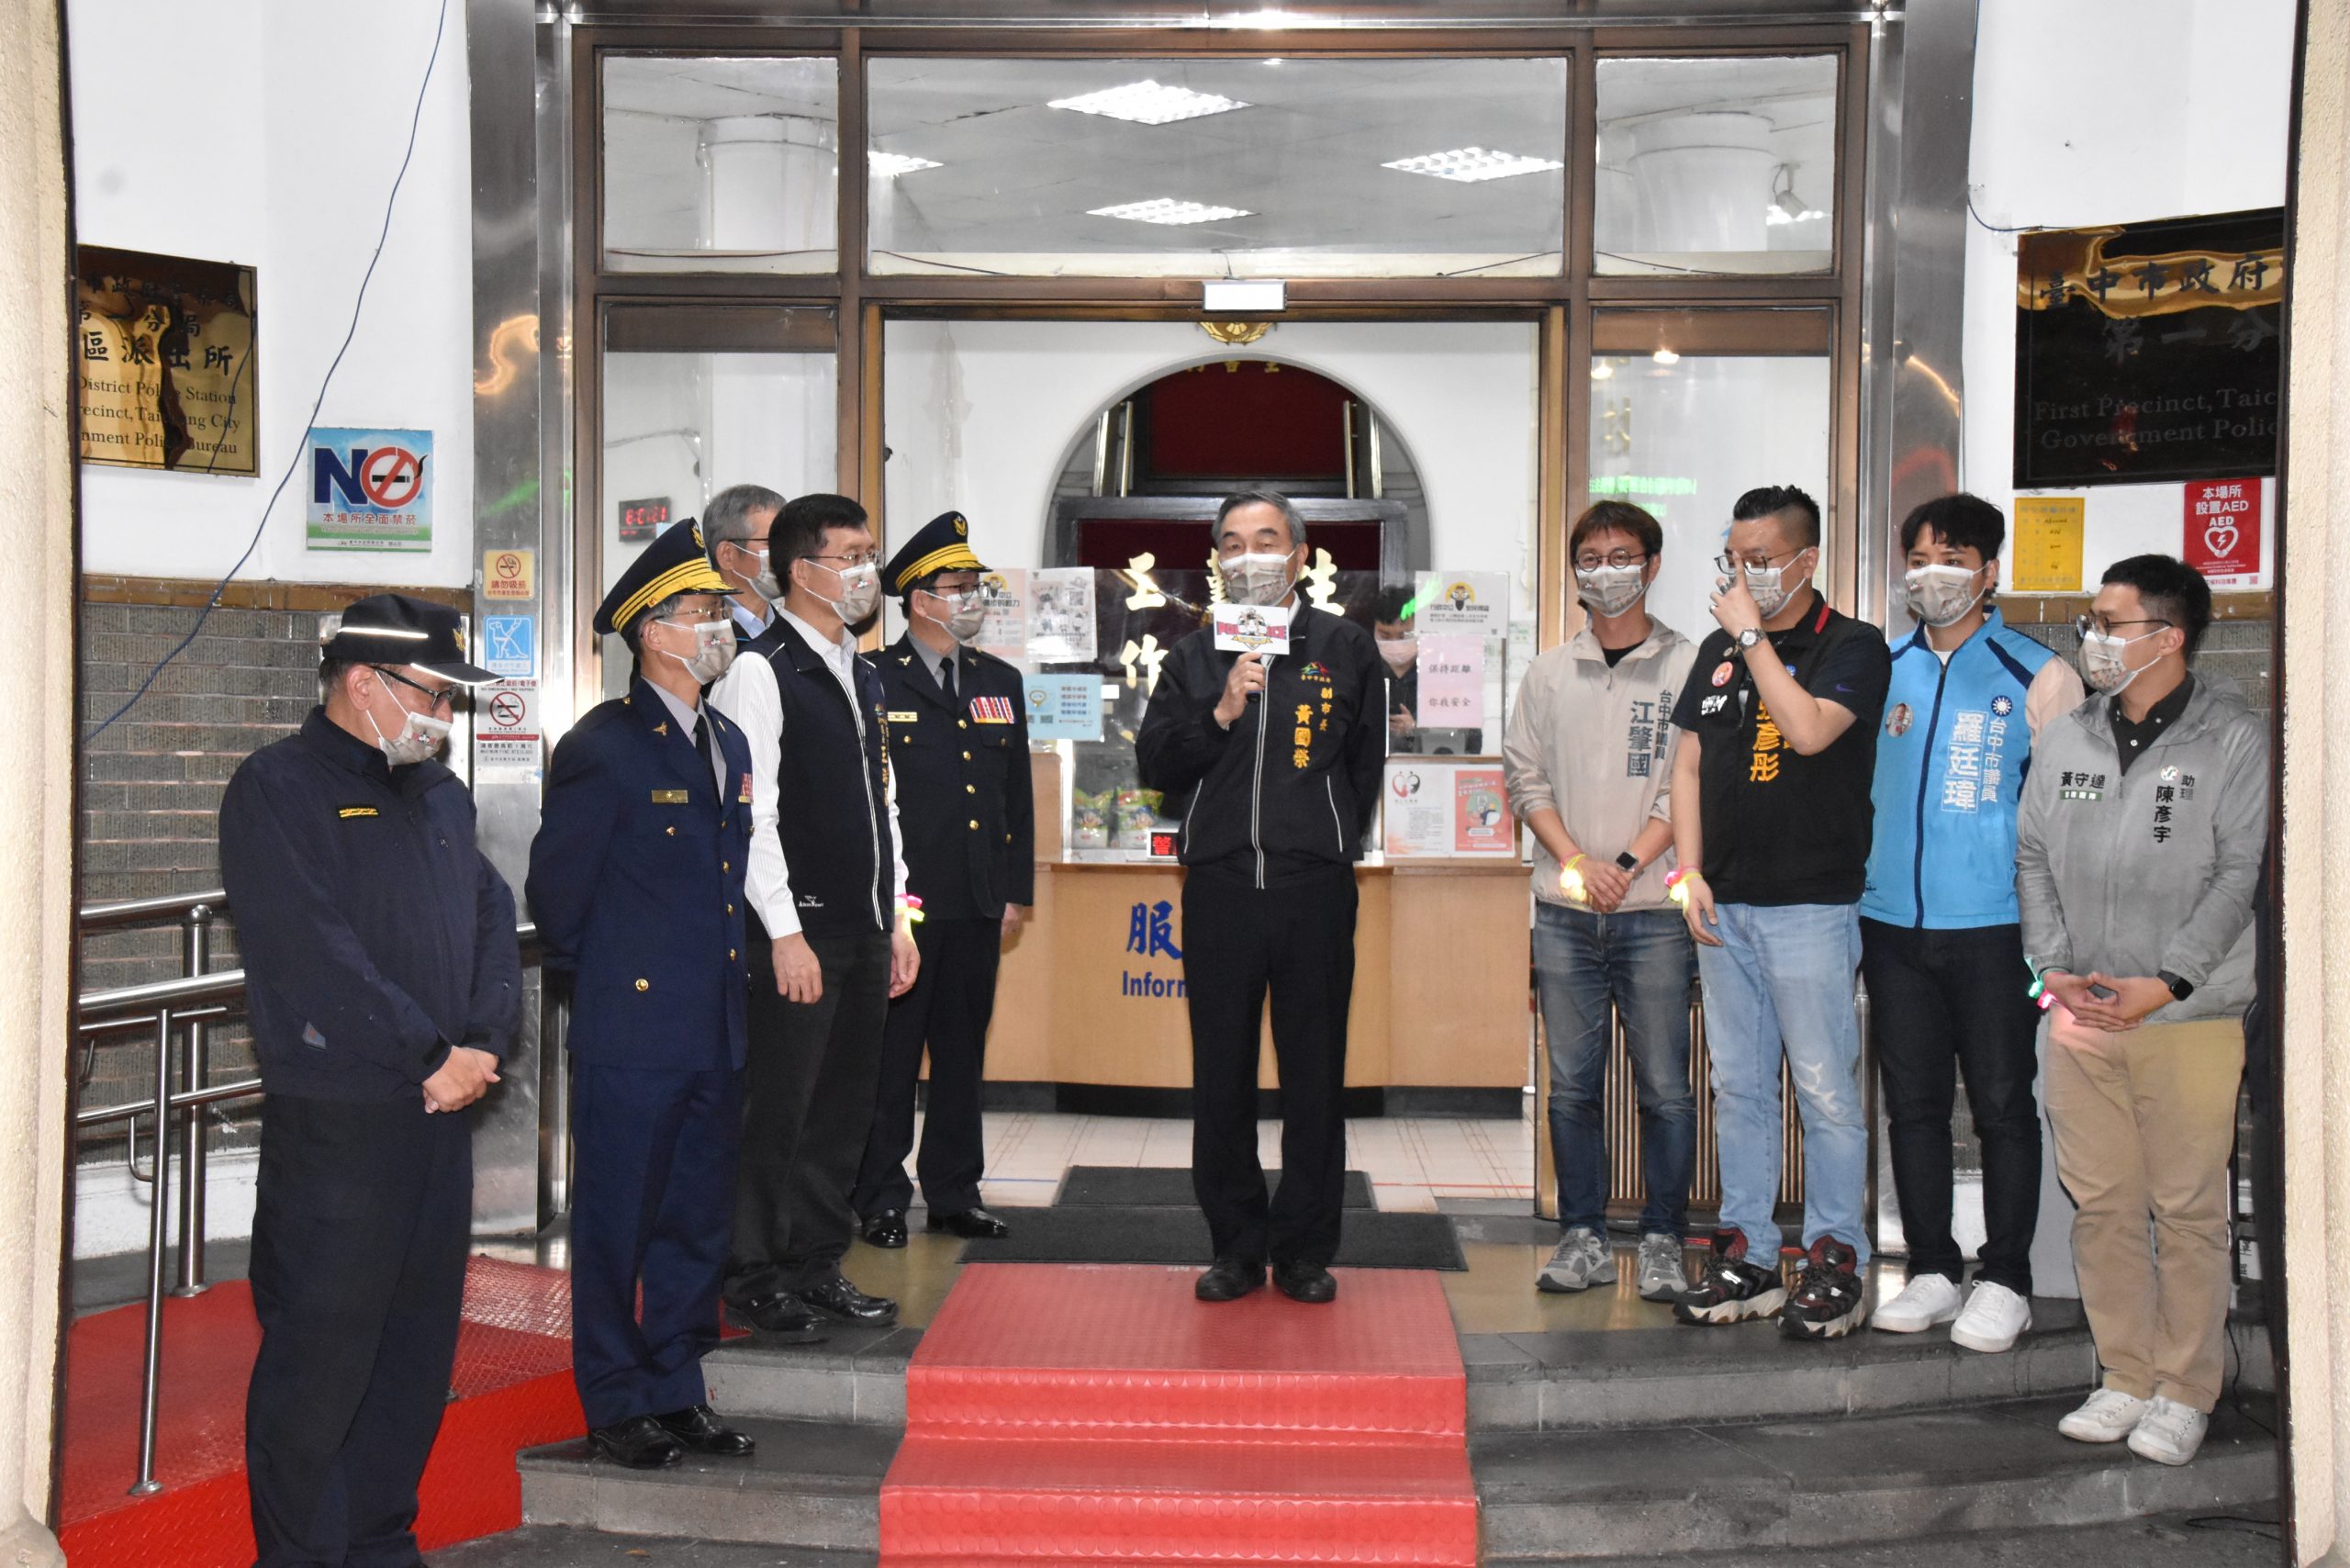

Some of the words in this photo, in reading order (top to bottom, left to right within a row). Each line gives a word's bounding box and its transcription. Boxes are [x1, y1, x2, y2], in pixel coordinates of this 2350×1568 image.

[2041, 252, 2268, 309] 臺中市政府
[84, 330, 234, 377] 區派出所
[137, 381, 181, 398] Pole
[185, 386, 237, 405] Station
[135, 407, 207, 430] Taing
[211, 413, 241, 433] City
[2033, 400, 2093, 422] First
[2098, 393, 2213, 419] Precinct,
[2042, 424, 2207, 449] Government
[2203, 485, 2242, 499] 本場所
[323, 513, 417, 525] 本場所全面禁菸
[2196, 500, 2248, 515] 設置AED
[2210, 516, 2234, 527] AED
[491, 580, 526, 589] 請勿吸菸
[1428, 664, 1471, 674] 保持距離
[1319, 687, 1333, 732] 副市長
[1428, 697, 1471, 708] 你我安全
[1654, 689, 1673, 760] 台中市議員
[1627, 700, 1655, 778] 江肇國
[1981, 716, 2007, 802] 台中市議員
[2061, 771, 2106, 790] 黃守達
[2180, 775, 2196, 801] 助理
[2154, 785, 2175, 843] 陳彥宇
[1152, 834, 1177, 856] 警
[1126, 901, 1183, 960] 服
